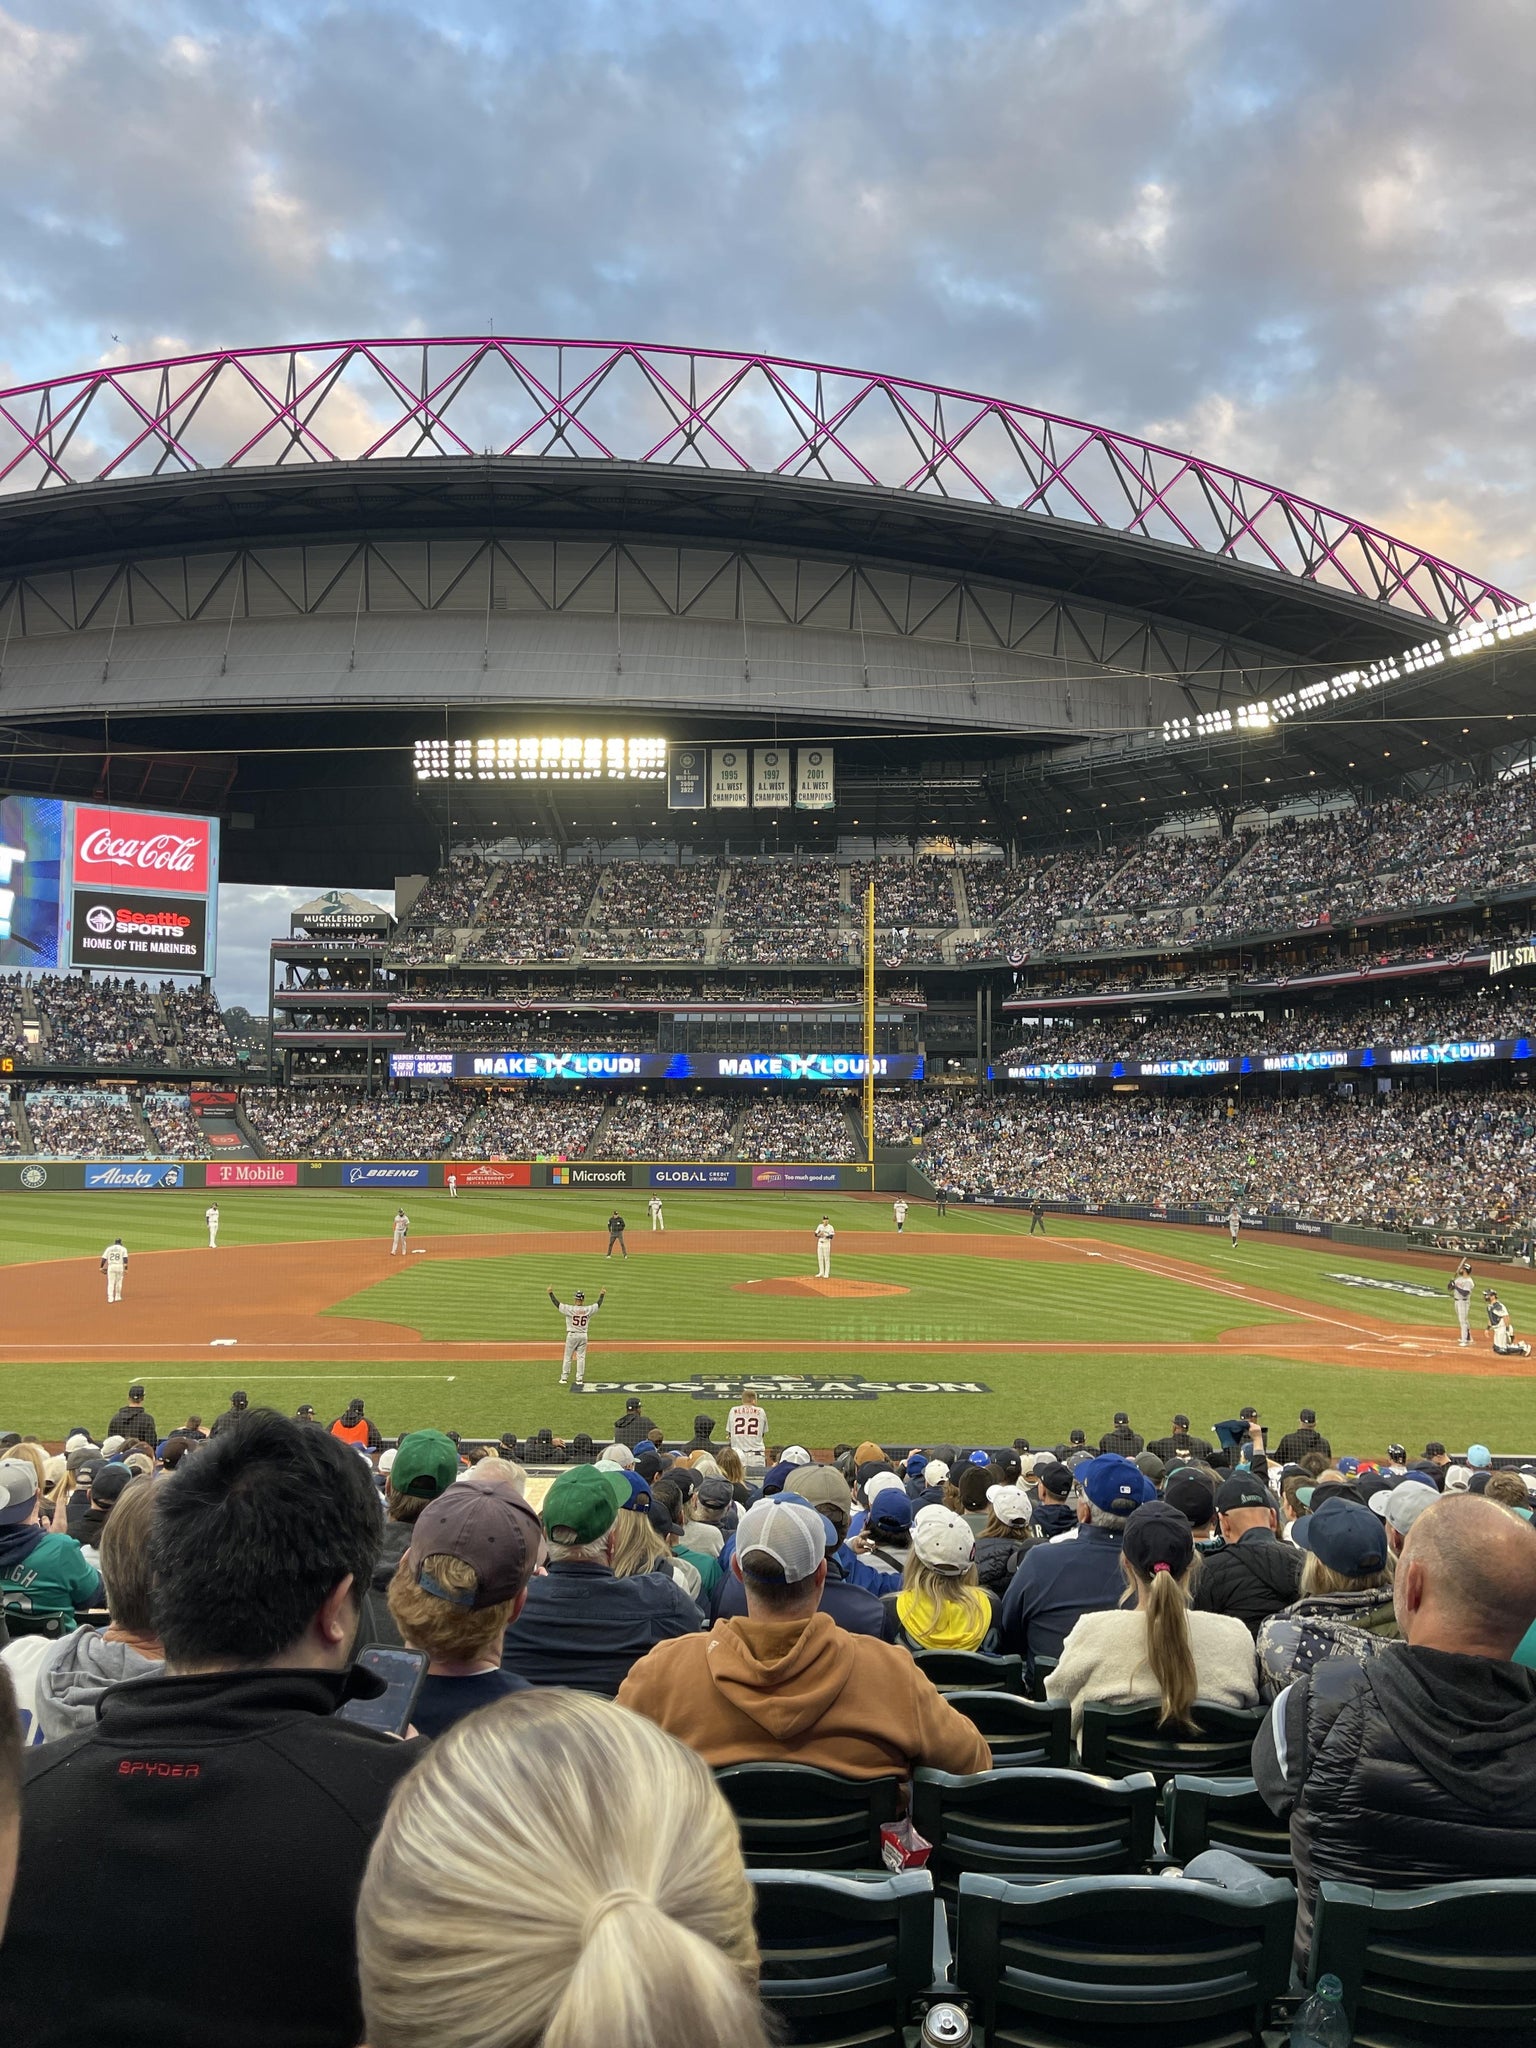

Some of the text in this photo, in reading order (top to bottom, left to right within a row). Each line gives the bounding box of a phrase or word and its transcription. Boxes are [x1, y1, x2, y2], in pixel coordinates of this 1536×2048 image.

[721, 770, 738, 780] 1995
[764, 770, 780, 780] 1997
[807, 769, 824, 779] 2001
[716, 782, 743, 791] A.L. WEST
[758, 782, 785, 791] A.L. WEST
[801, 782, 829, 790] A.L. WEST
[713, 792, 746, 802] CHAMPIONS
[755, 792, 788, 802] CHAMPIONS
[798, 792, 832, 801] CHAMPIONS
[80, 828, 202, 873] Coca-Cola
[116, 908, 191, 928] Seattle
[303, 915, 376, 923] MUCKLESHOOT
[116, 922, 184, 937] SPORTS
[83, 937, 197, 955] HOME OF THE MARINERS
[1489, 950, 1511, 976] ALL
[1390, 1043, 1496, 1063] MAKE IT LOUD!
[474, 1058, 641, 1074] MAKE IT LOUD!
[719, 1059, 888, 1075] MAKE IT LOUD!
[1141, 1060, 1230, 1075] MAKE IT LOUD!
[1263, 1053, 1348, 1070] MAKE IT LOUD!
[417, 1061, 453, 1075] $102,745
[1008, 1065, 1096, 1078] MAKE IT LOUD!
[90, 1167, 152, 1186] Alaska
[236, 1166, 285, 1181] Mobile
[366, 1169, 420, 1177] BOEING
[572, 1170, 626, 1182] Microsoft
[656, 1171, 706, 1182] GLOBAL
[809, 1174, 822, 1182] good
[1295, 1222, 1321, 1234] Booking.com
[109, 1252, 121, 1261] 28
[572, 1315, 588, 1326] 56
[581, 1382, 985, 1393] POSTSEASON
[734, 1407, 761, 1416] MEADOWS
[734, 1417, 760, 1436] 22
[118, 1761, 200, 1777] SPYDER
